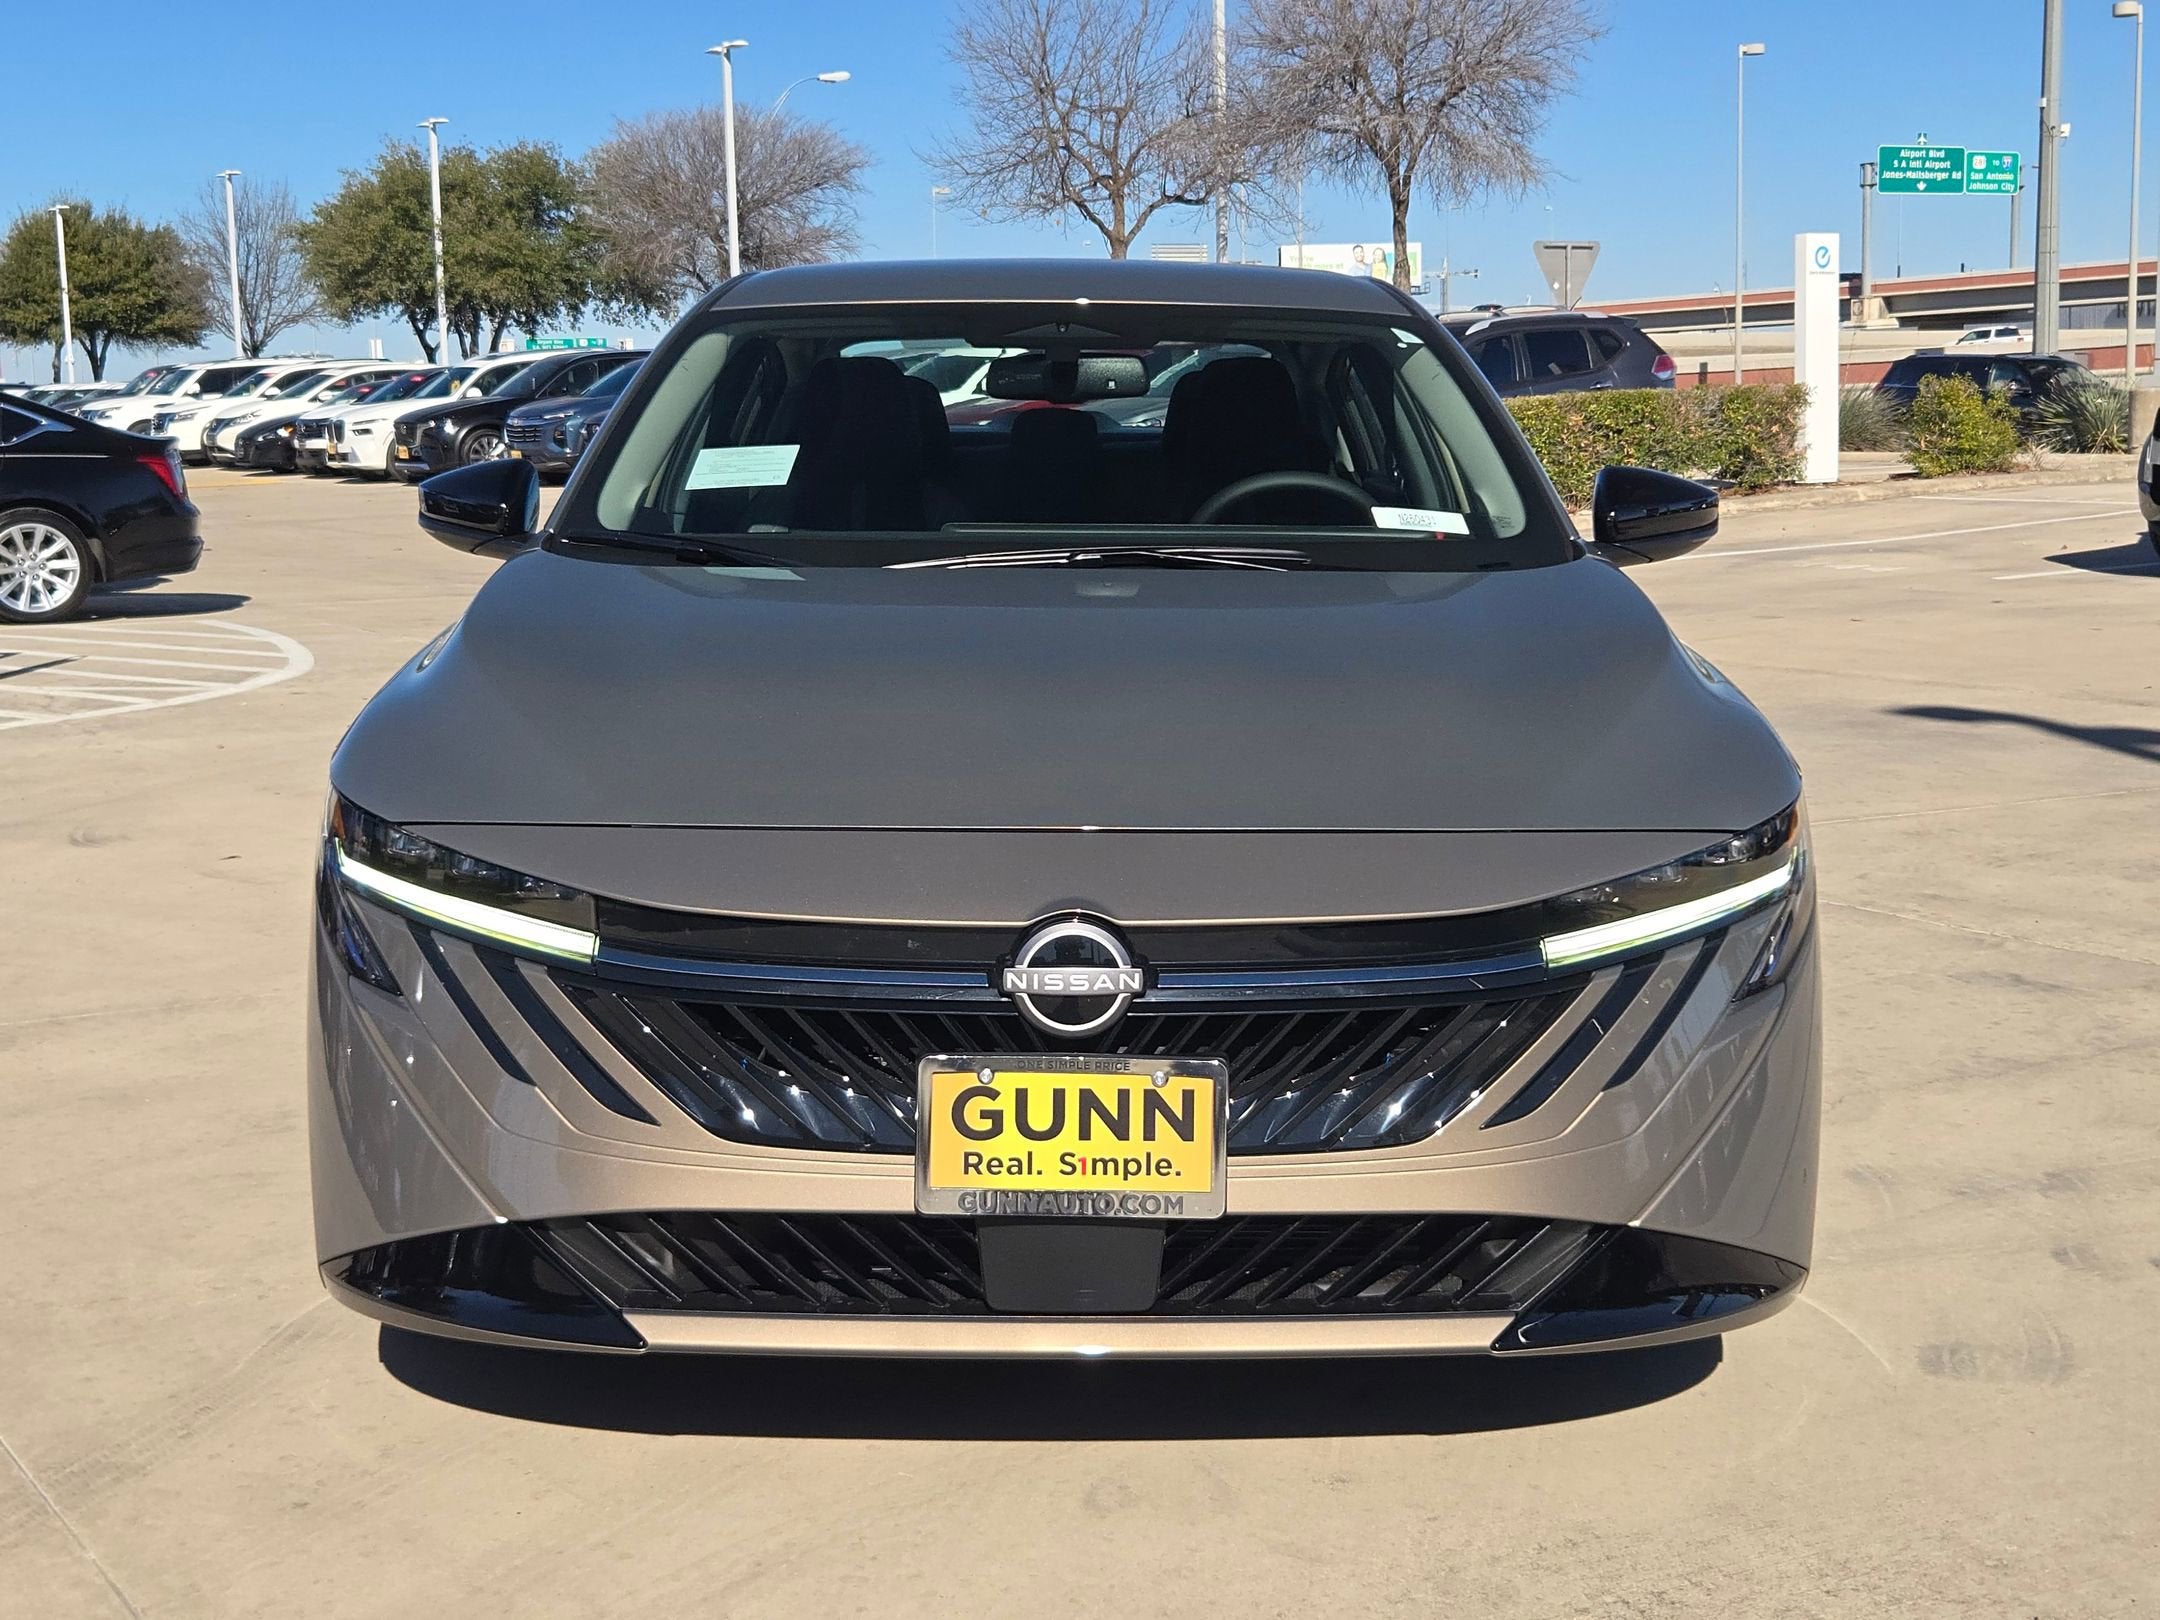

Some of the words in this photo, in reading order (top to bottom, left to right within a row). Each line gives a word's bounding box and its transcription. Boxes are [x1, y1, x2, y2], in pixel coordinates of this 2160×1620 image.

[1899, 149, 1926, 158] Airport
[1928, 149, 1945, 158] Blvd
[1893, 160, 1899, 168] S
[1900, 160, 1907, 168] A
[1924, 160, 1951, 169] Airport
[1951, 171, 1962, 180] Rd
[1970, 172, 1984, 180] San
[1986, 172, 2014, 180] Antonio
[1968, 181, 1999, 190] Johnson
[2000, 182, 2015, 192] City
[1006, 972, 1140, 991] NISSAN
[1017, 1060, 1043, 1069] ONE
[1047, 1060, 1092, 1070] SIMPLE
[1094, 1061, 1131, 1071] PRICE
[951, 1085, 1195, 1142] GUNN
[963, 1151, 1043, 1176] Real.
[957, 1191, 1184, 1216] GUNNAUTO.COM
